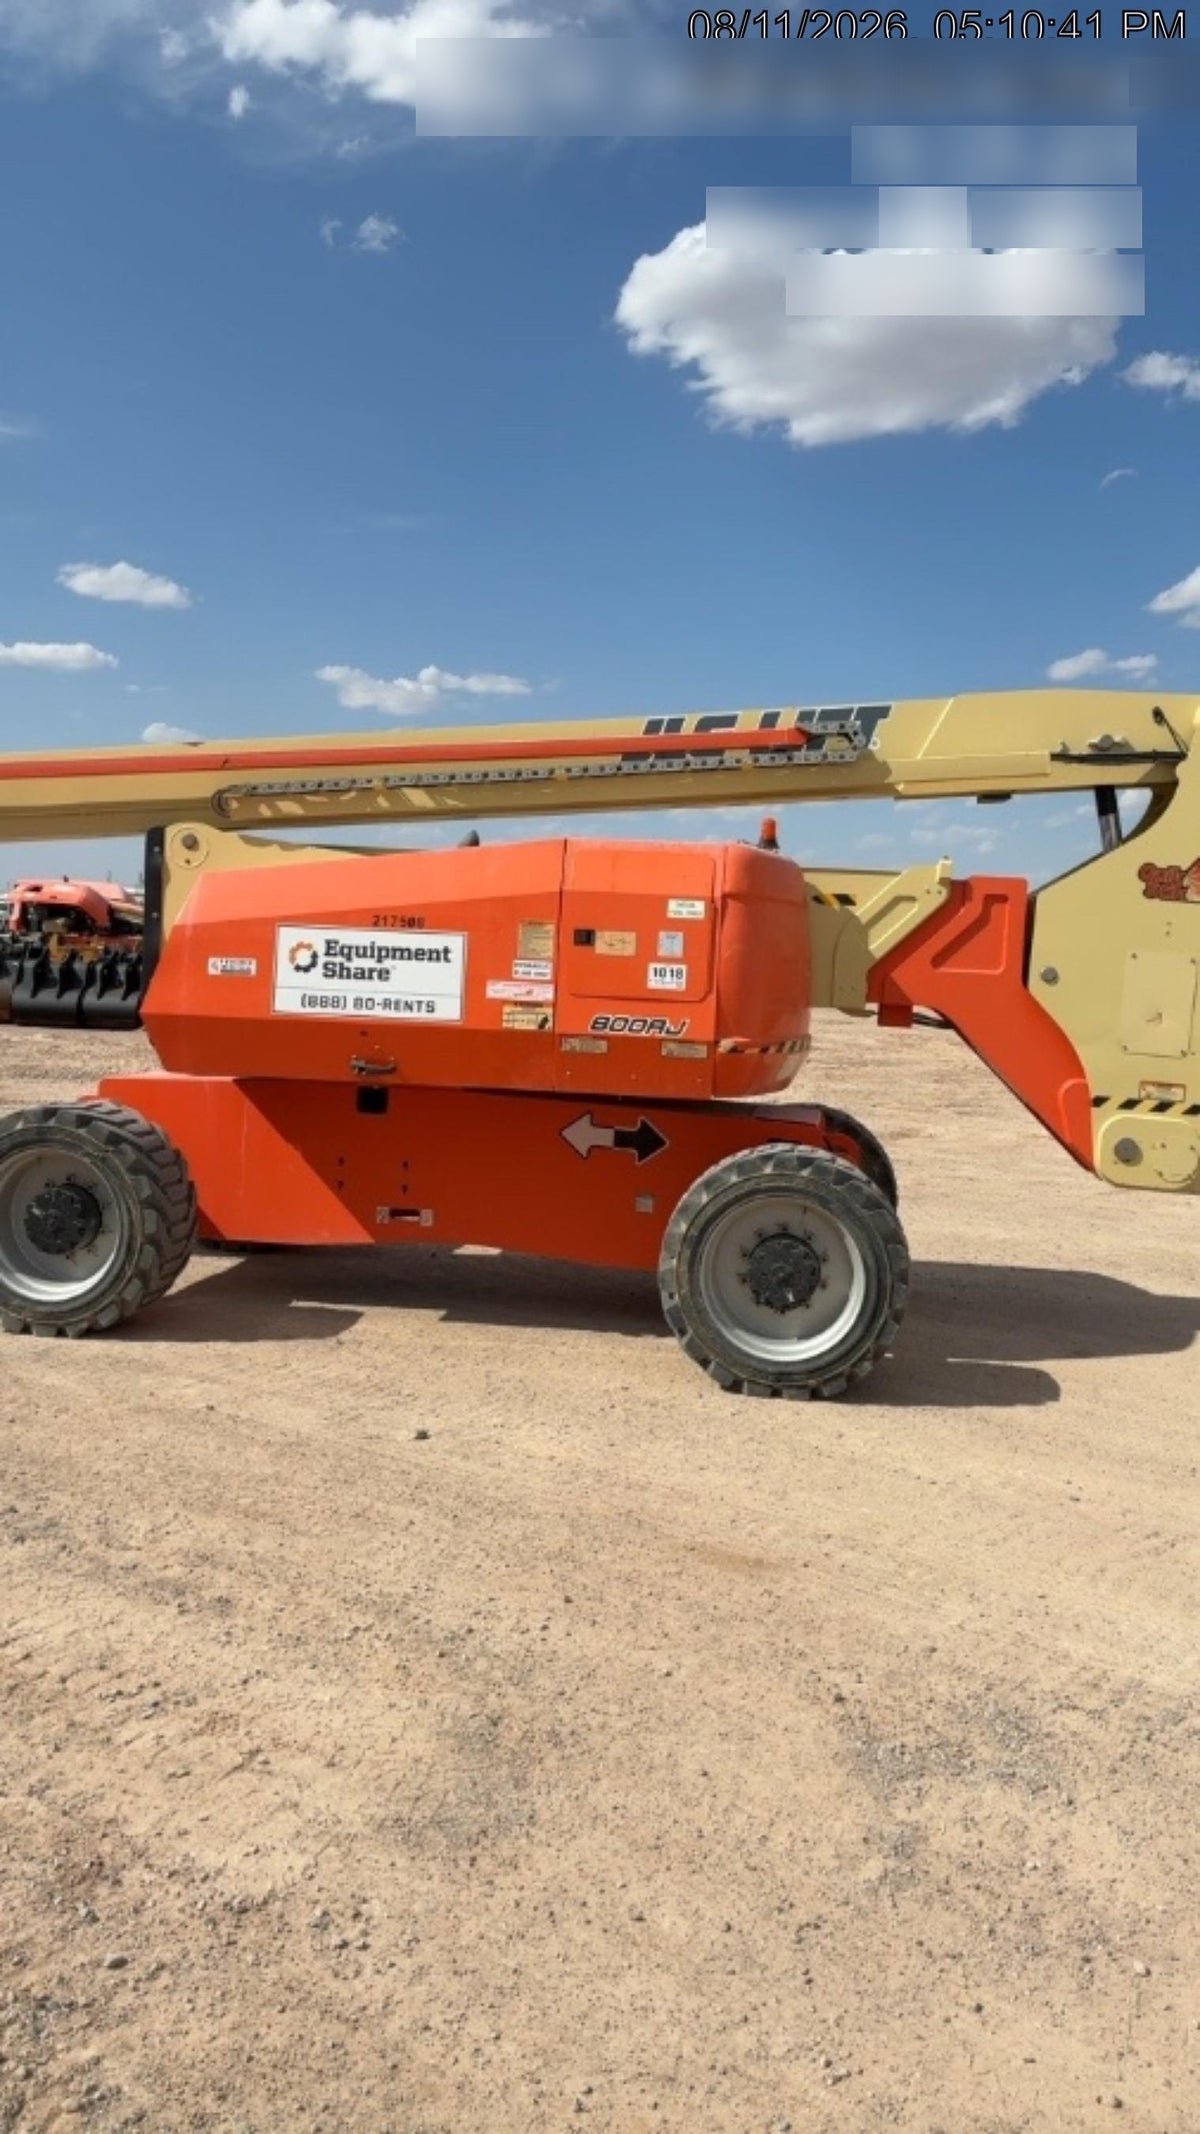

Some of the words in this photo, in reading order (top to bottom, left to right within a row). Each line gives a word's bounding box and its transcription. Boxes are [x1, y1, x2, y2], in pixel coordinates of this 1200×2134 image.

[324, 939, 452, 963] Equipment
[322, 961, 391, 981] Share
[652, 966, 684, 980] 1018
[301, 993, 347, 1010] (888)
[353, 997, 436, 1013] 80-RENTS
[589, 1015, 688, 1036] 800AJ
